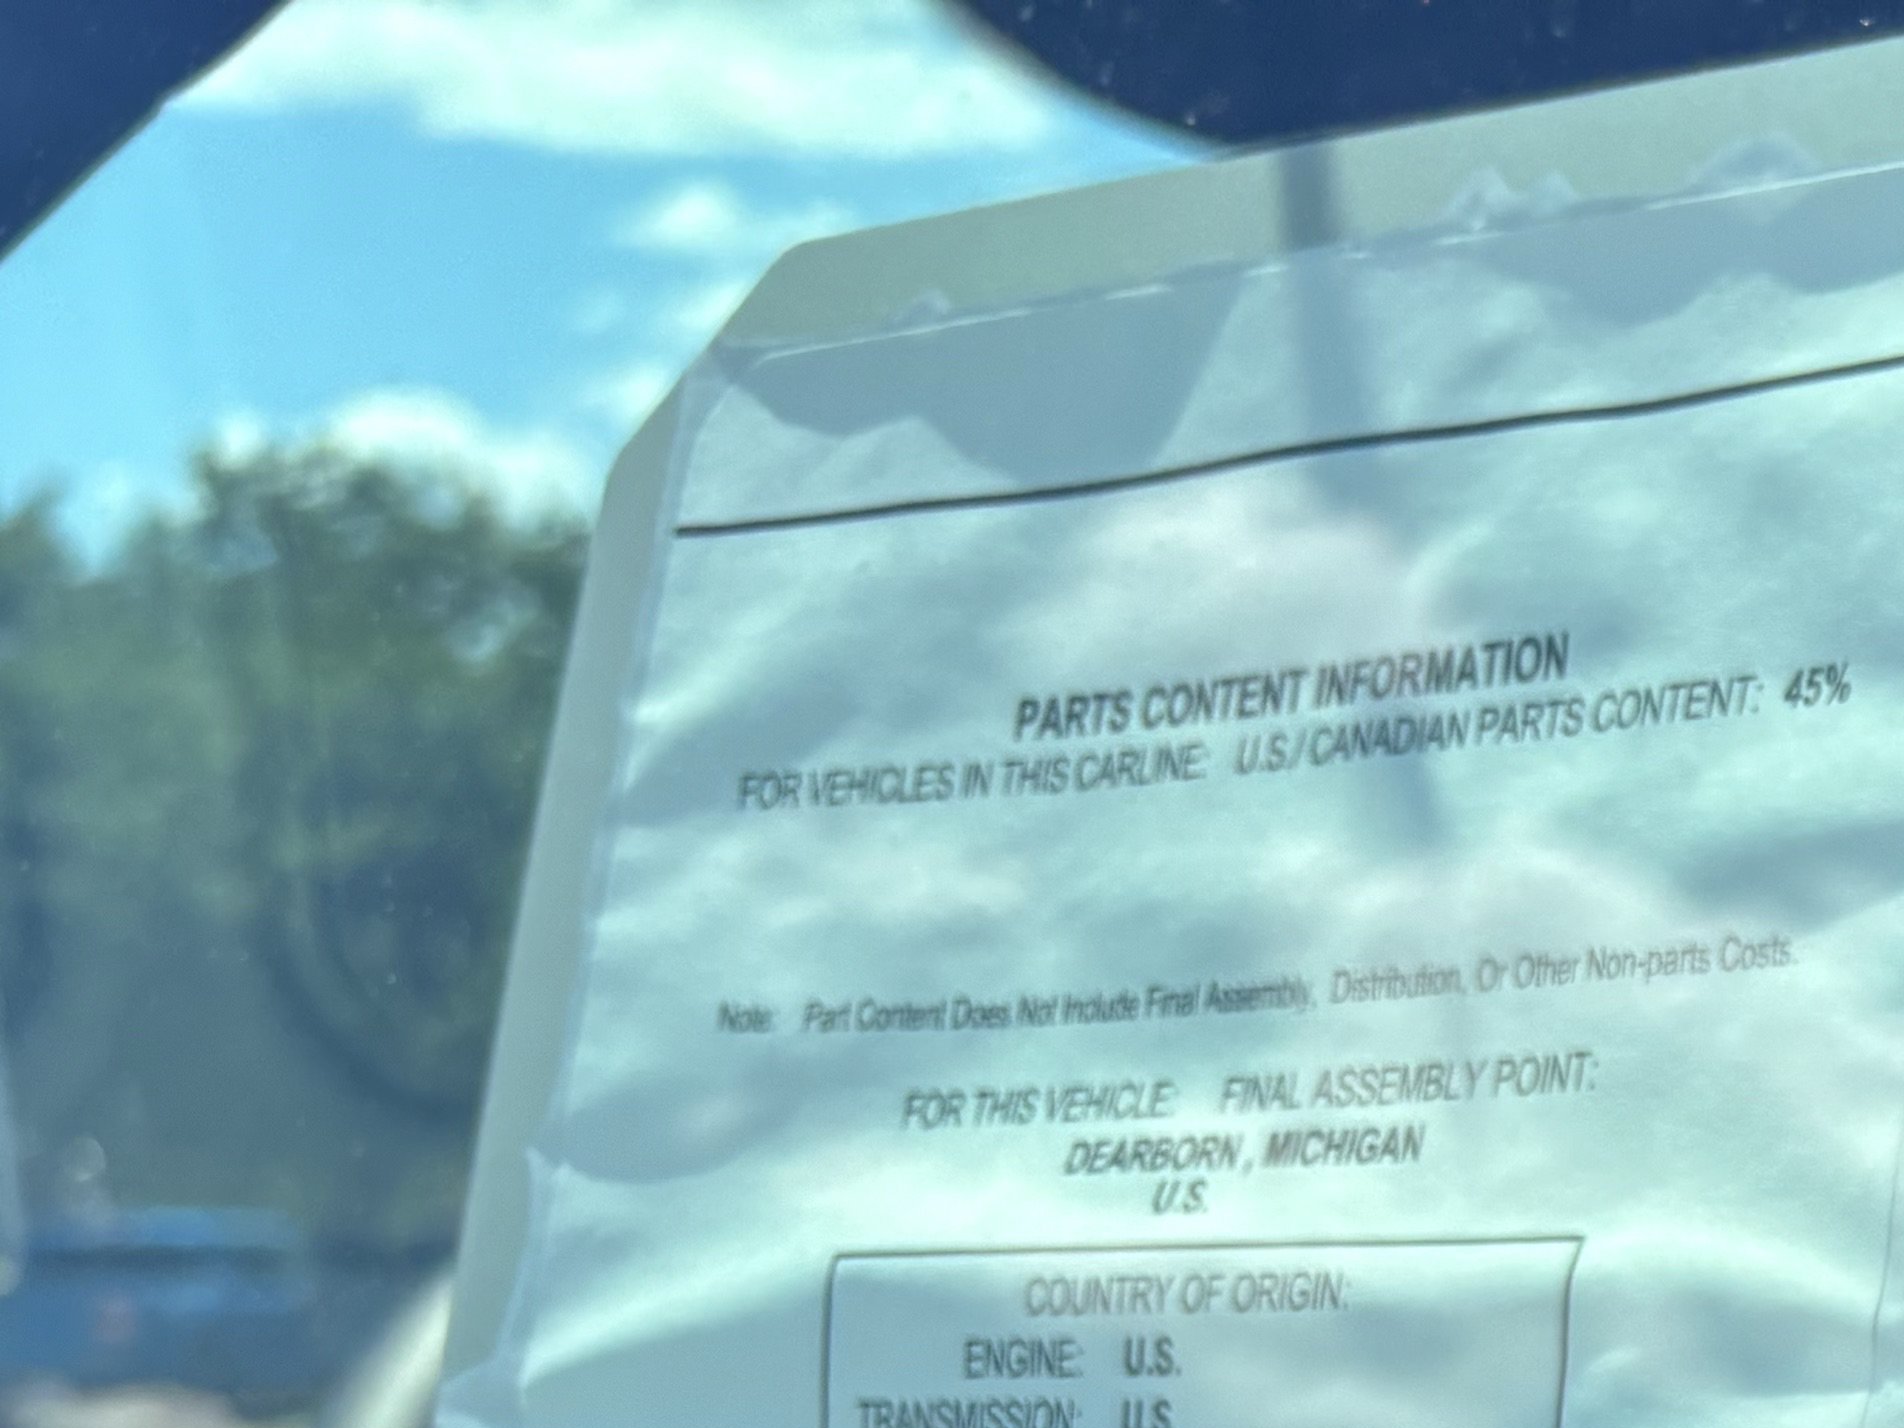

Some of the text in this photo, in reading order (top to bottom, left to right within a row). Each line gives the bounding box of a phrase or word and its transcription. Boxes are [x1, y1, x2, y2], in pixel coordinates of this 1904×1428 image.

[1013, 631, 1570, 741] PARTS CONTENT INFORMATION
[737, 772, 803, 811] FOR
[805, 759, 957, 807] VEHICLES
[962, 759, 995, 798] IN
[1001, 755, 1072, 797] THIS
[1474, 697, 1585, 746] PARTS
[1590, 675, 1765, 734] CONTENT:
[1783, 661, 1853, 709] 45%
[1059, 988, 1140, 1025] Include
[1143, 982, 1200, 1018] Final
[1474, 957, 1508, 993] Or
[1510, 951, 1581, 989] Other
[1584, 940, 1711, 983] Non-parts
[901, 1088, 967, 1129] FOR
[973, 1086, 1040, 1125] THIS
[1219, 1073, 1301, 1113] FINAL
[1307, 1058, 1490, 1108] ASSEMBLY
[1492, 1050, 1600, 1099] POINT:
[1262, 1123, 1427, 1169] MICHIGAN
[1025, 1271, 1352, 1317] COUNTRY OF ORIGIN:
[963, 1335, 1182, 1380] ENGINE: U.S.
